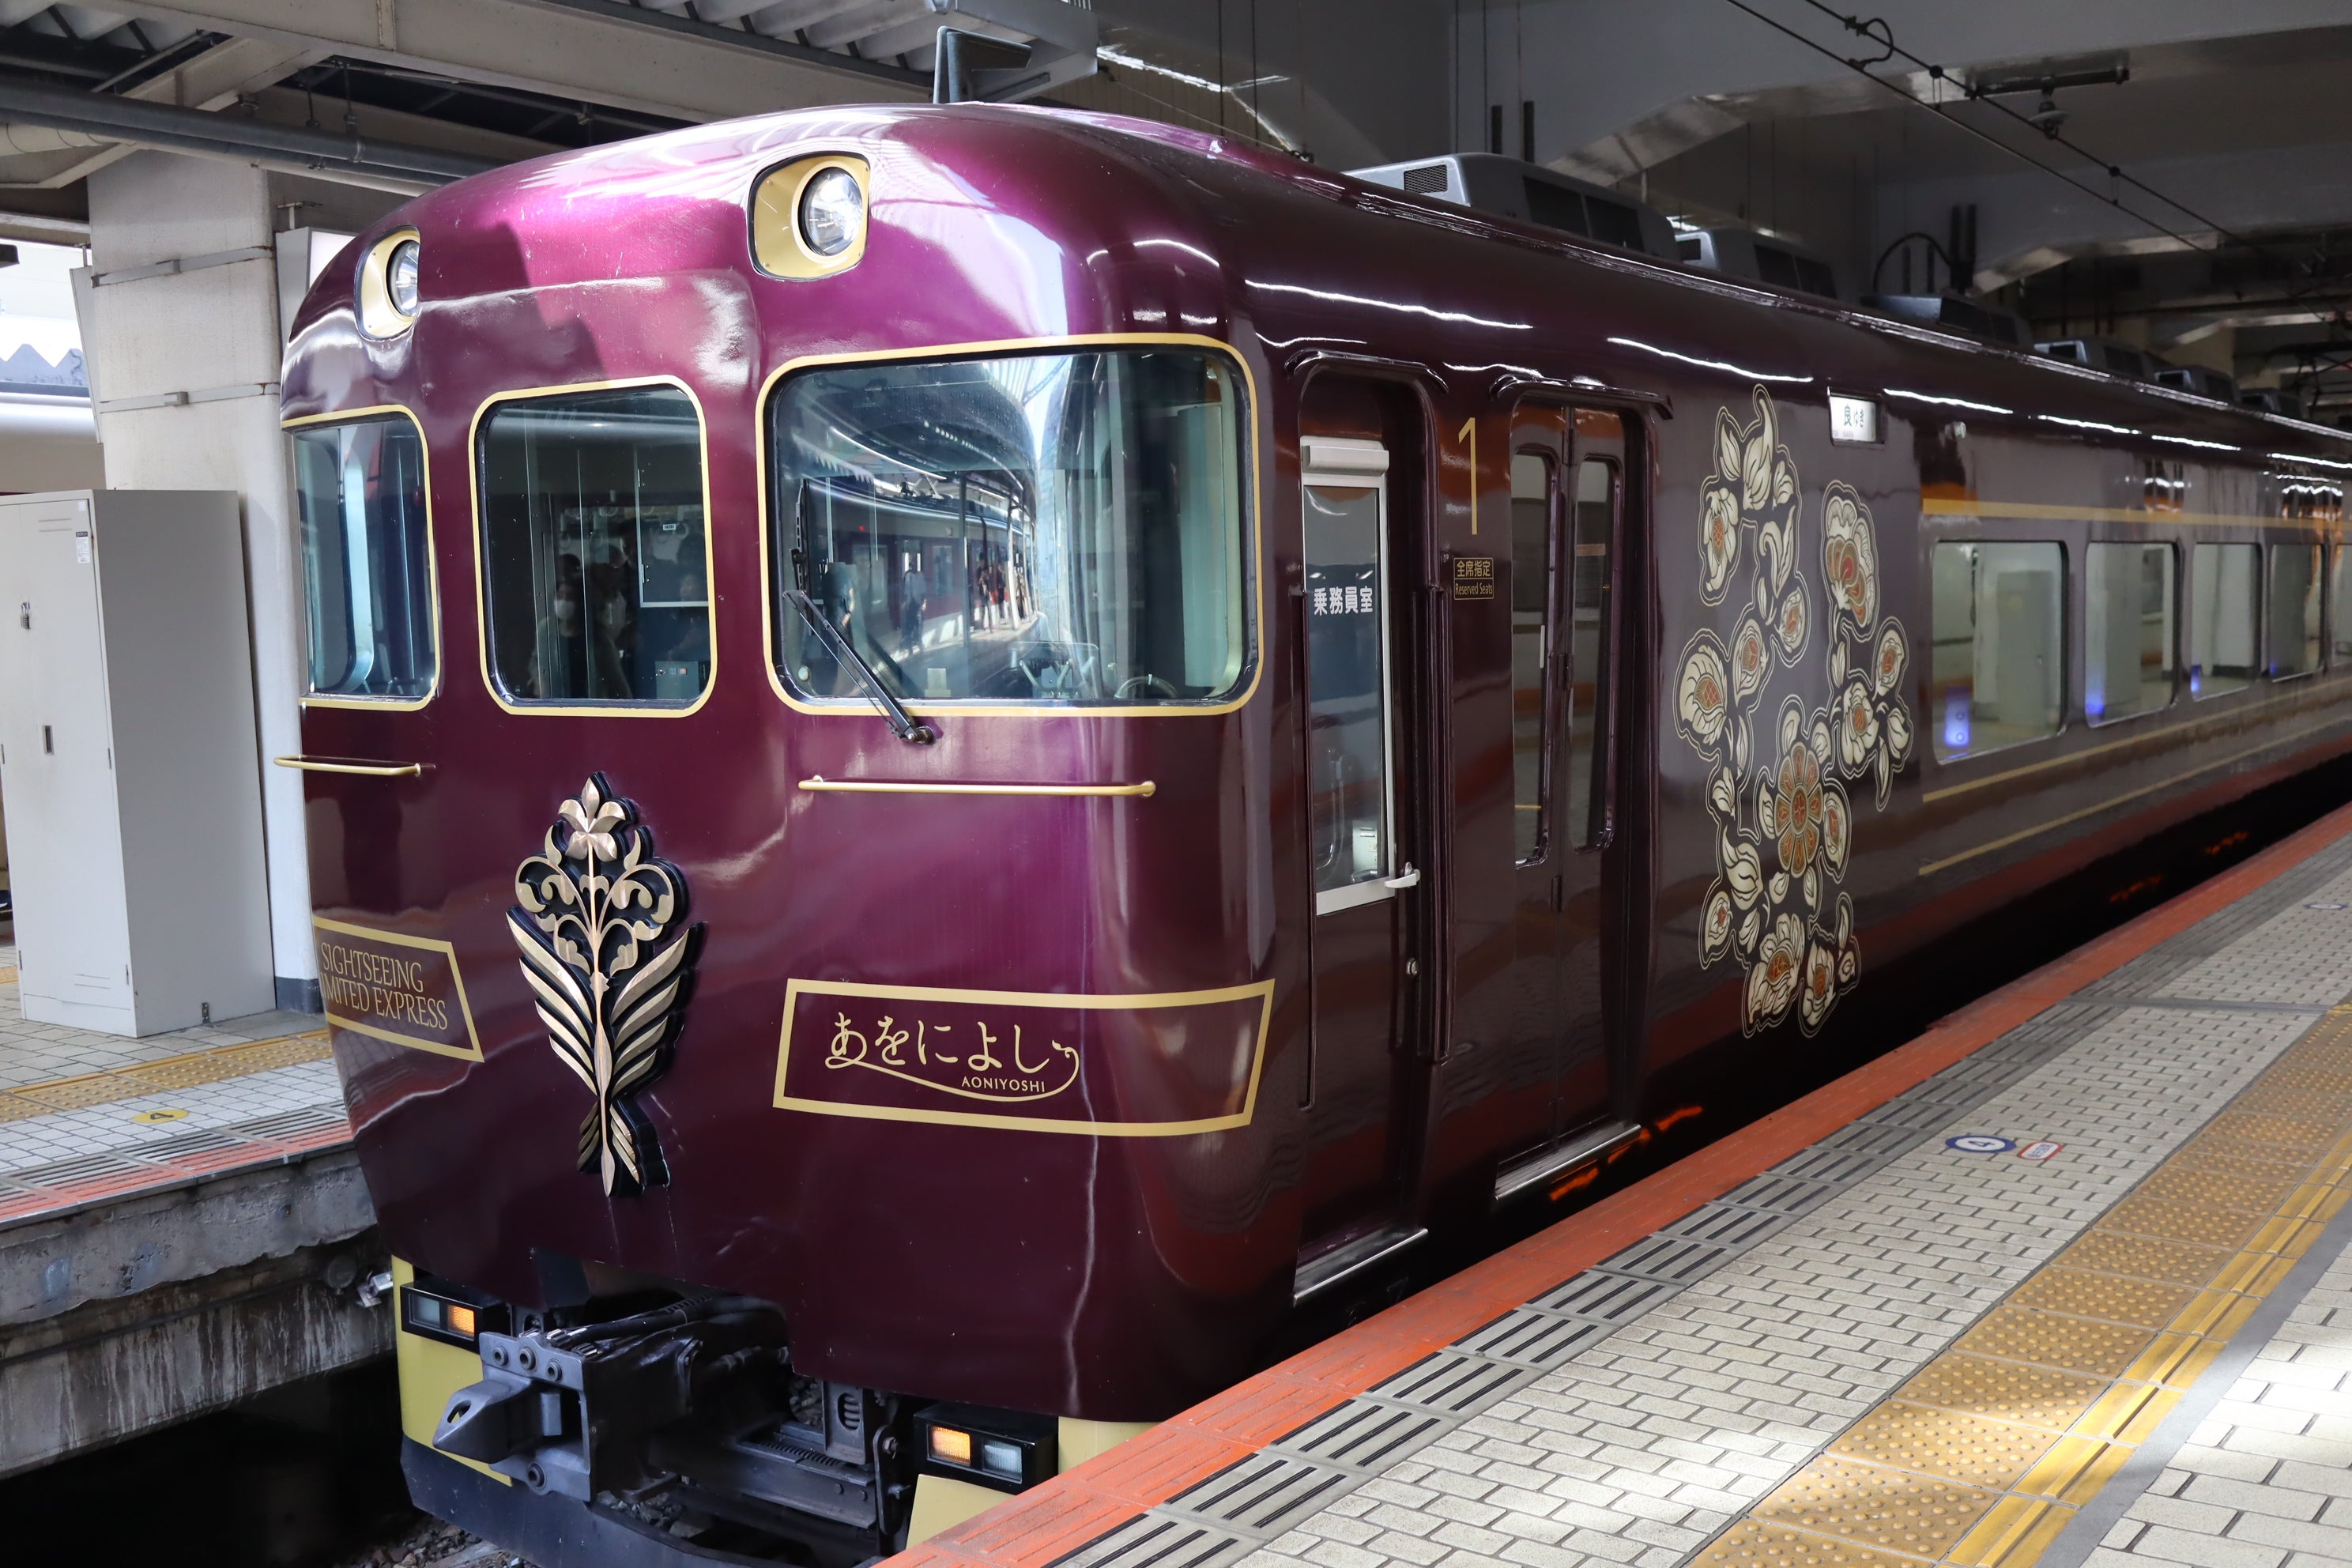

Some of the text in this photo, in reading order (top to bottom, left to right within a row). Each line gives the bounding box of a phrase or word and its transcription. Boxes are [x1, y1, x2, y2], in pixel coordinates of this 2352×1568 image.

[1458, 416, 1477, 535] 1
[1457, 560, 1491, 577] 全席指定
[1314, 586, 1373, 616] 乗務員室
[1455, 582, 1493, 595] Reserved Seats
[321, 942, 424, 993] SIGHTSEEING
[372, 986, 448, 1031] EXPRESS
[825, 1012, 1050, 1073] あをによし
[962, 1075, 1046, 1093] AONIYOSHI
